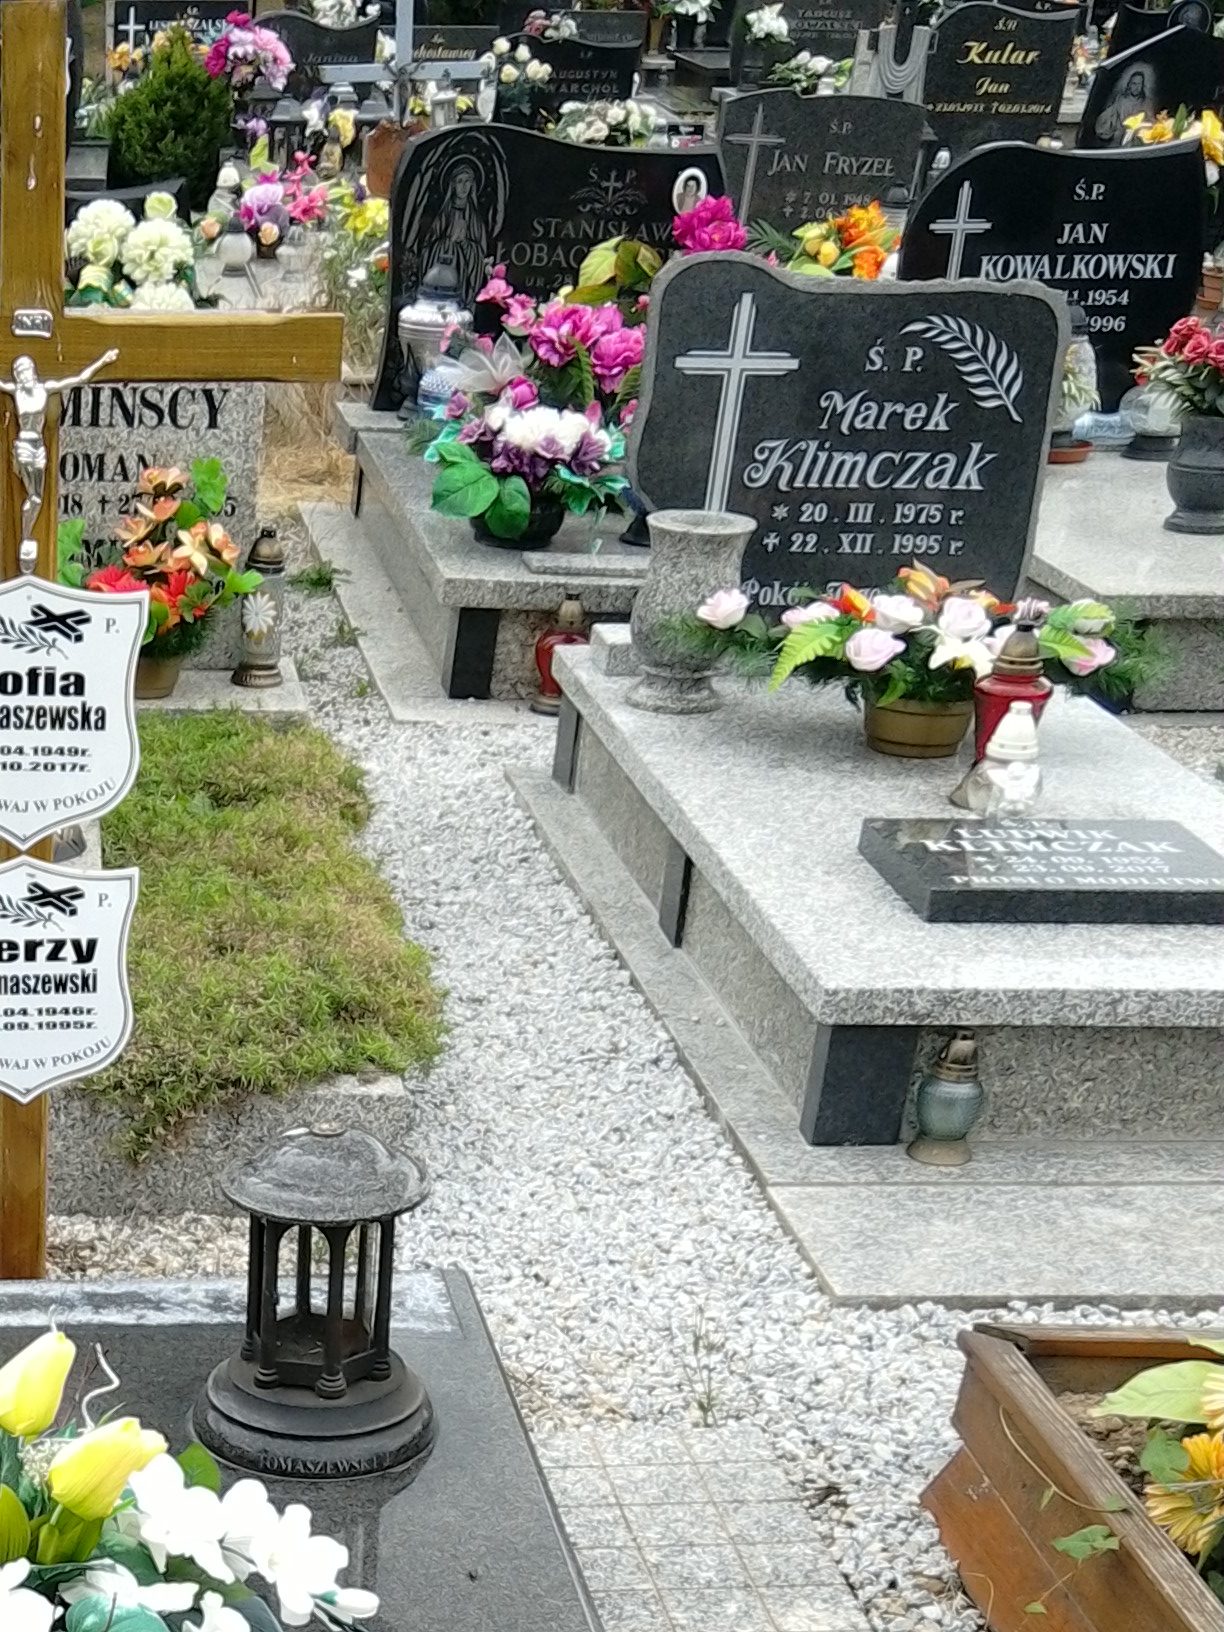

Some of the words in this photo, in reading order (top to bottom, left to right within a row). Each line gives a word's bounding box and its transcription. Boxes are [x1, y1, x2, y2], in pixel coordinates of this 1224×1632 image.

[767, 149, 809, 177] JAN
[822, 152, 896, 177] FRYZEŁ
[1056, 222, 1110, 245] JAN
[978, 252, 1178, 281] KOWALKOWSKI
[818, 390, 960, 436] Marek
[743, 438, 999, 492] Klimczak
[892, 503, 944, 525] 1975
[892, 534, 943, 555] 1995
[33, 800, 49, 814] W
[53, 776, 118, 812] POKOJU
[921, 839, 1184, 853] KLIMCZAK
[953, 828, 1120, 840] LUDWIK
[32, 1056, 49, 1070] W
[52, 1036, 112, 1069] POKOJU
